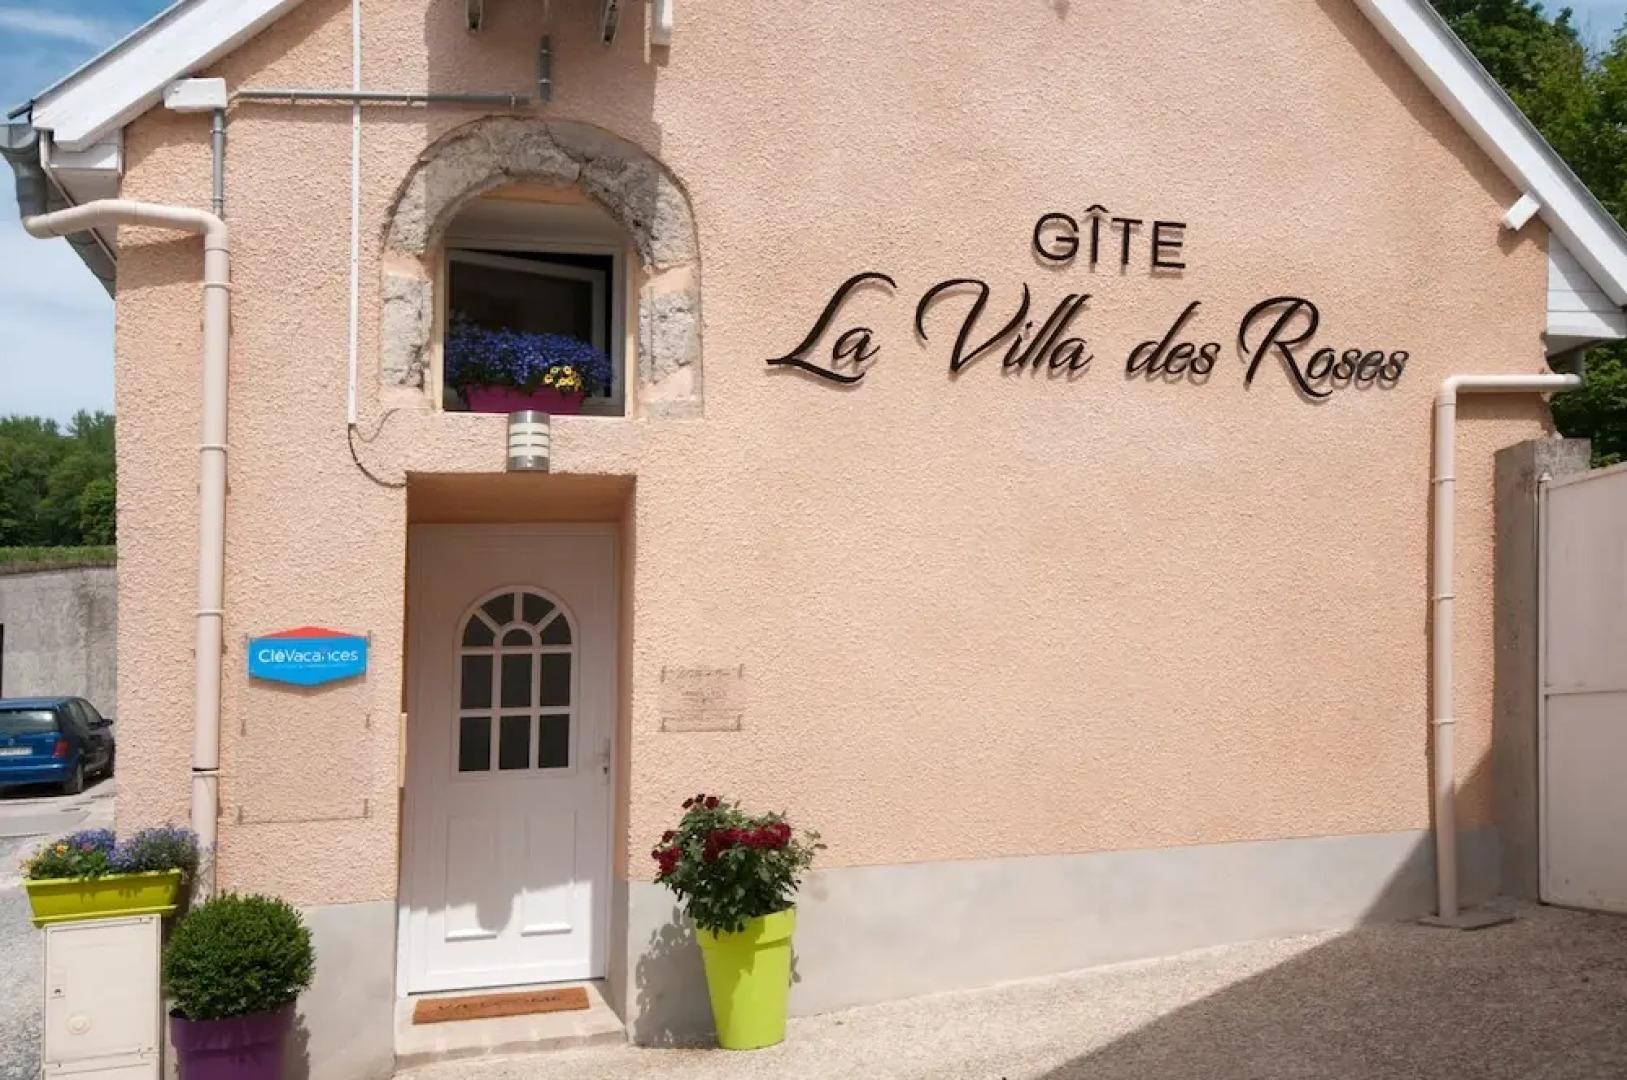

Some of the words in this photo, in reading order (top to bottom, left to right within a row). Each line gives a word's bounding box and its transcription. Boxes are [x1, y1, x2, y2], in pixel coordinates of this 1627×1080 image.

[1033, 204, 1187, 270] GÎTE
[765, 272, 897, 385] La
[915, 279, 1094, 376] Villa
[1125, 300, 1221, 376] des
[1238, 296, 1410, 400] Roses
